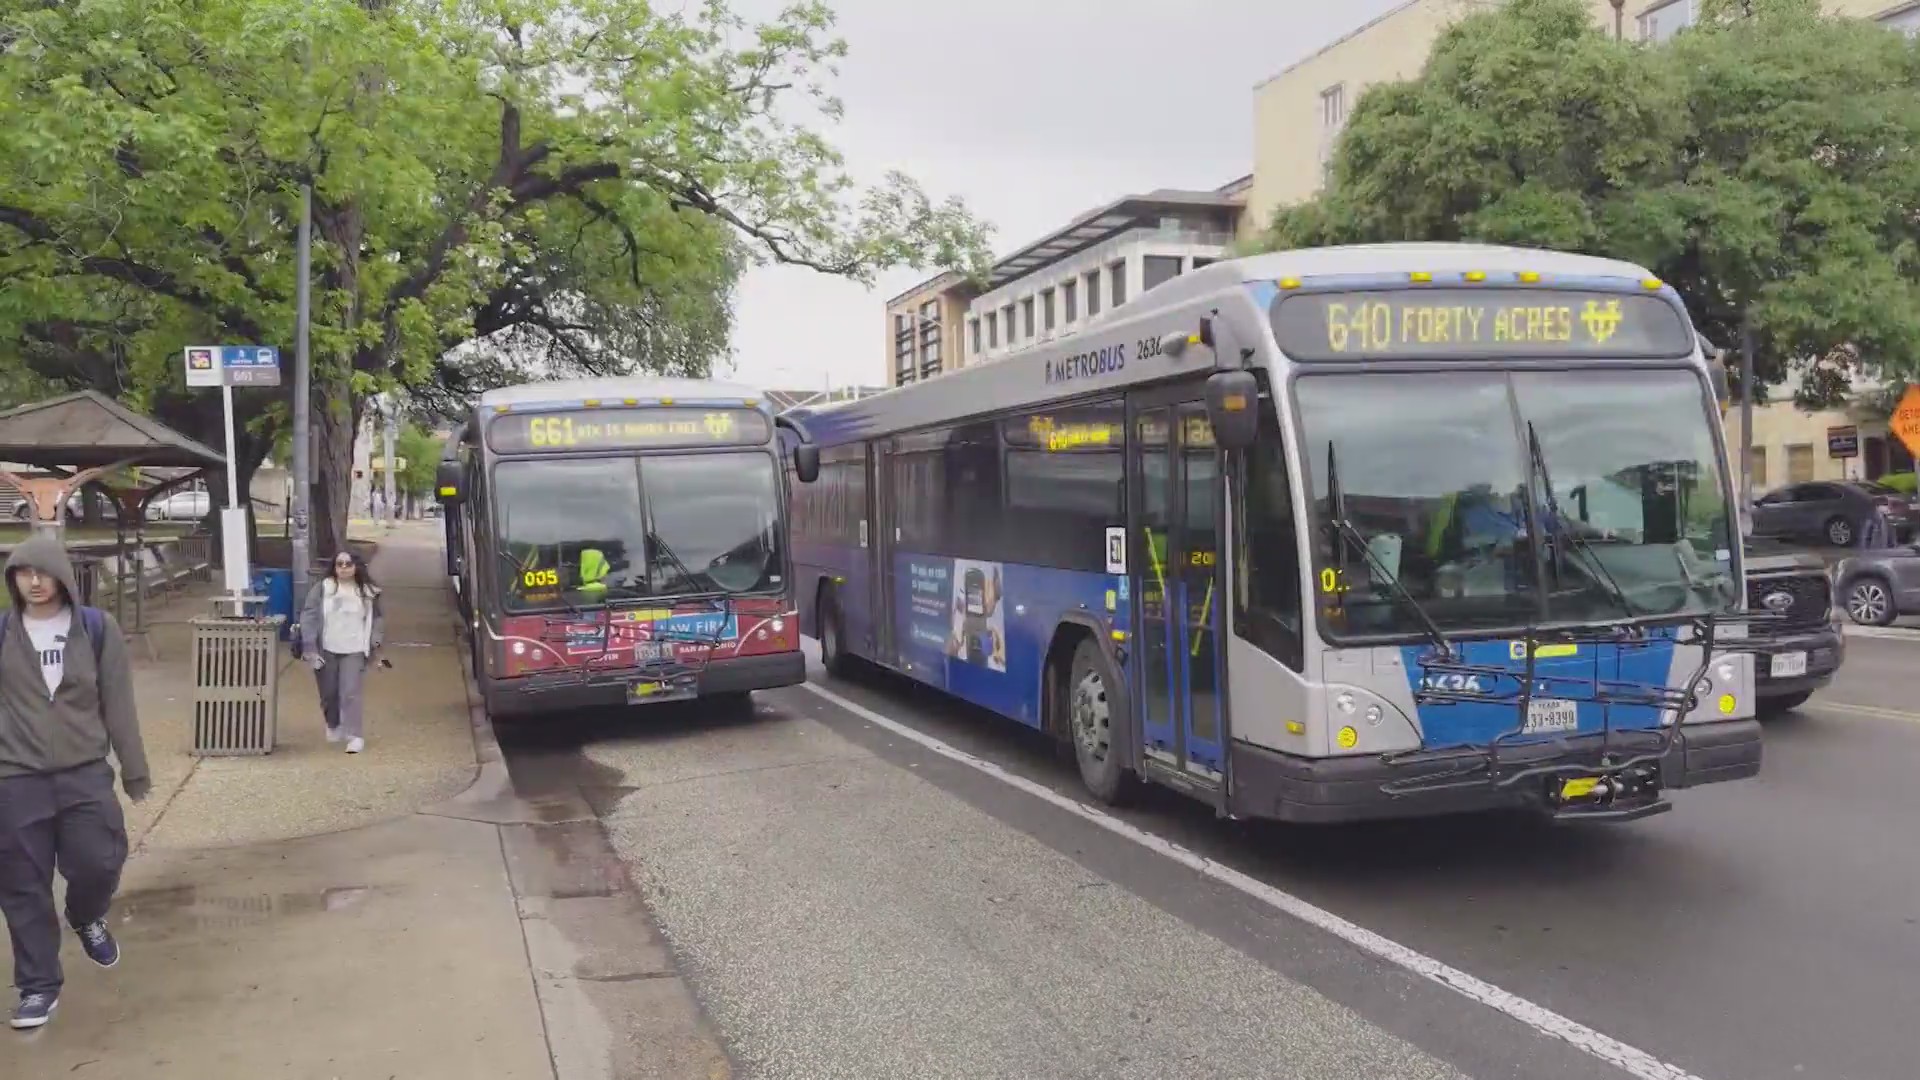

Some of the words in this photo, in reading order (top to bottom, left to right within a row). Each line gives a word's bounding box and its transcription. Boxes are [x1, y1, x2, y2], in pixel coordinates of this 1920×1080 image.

[1327, 302, 1392, 352] 640
[1402, 305, 1485, 343] FORTY
[1495, 305, 1572, 342] ACRES
[1055, 343, 1125, 382] METROBUS
[530, 416, 577, 447] 661
